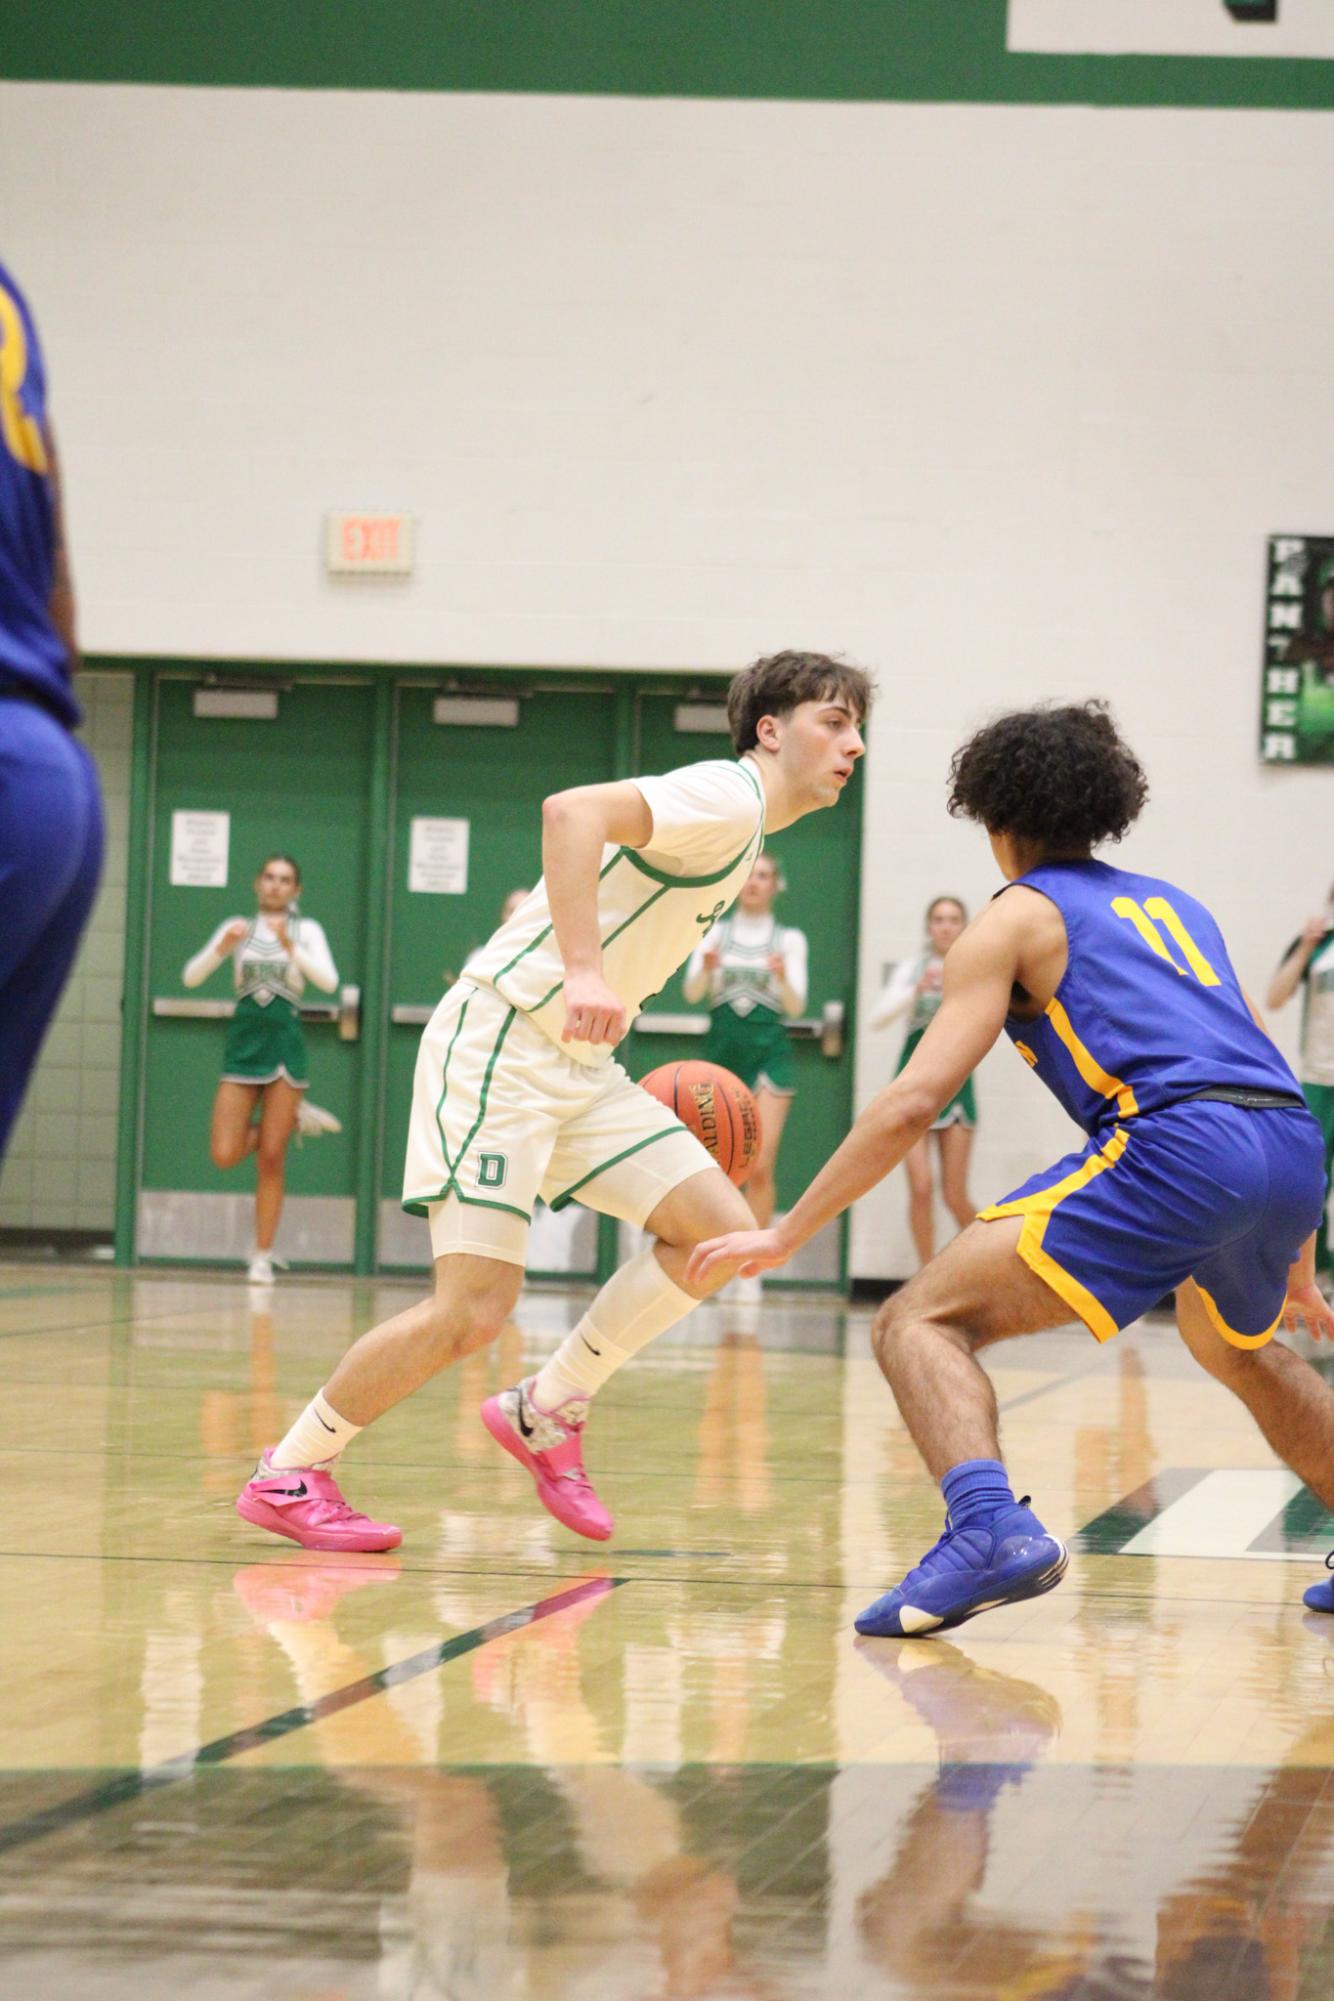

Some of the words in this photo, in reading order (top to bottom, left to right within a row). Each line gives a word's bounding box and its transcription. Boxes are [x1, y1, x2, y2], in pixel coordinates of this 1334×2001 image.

[342, 517, 401, 561] EXIT
[1109, 896, 1222, 987] 11
[690, 1083, 720, 1157] ALDING
[476, 1151, 508, 1189] D
